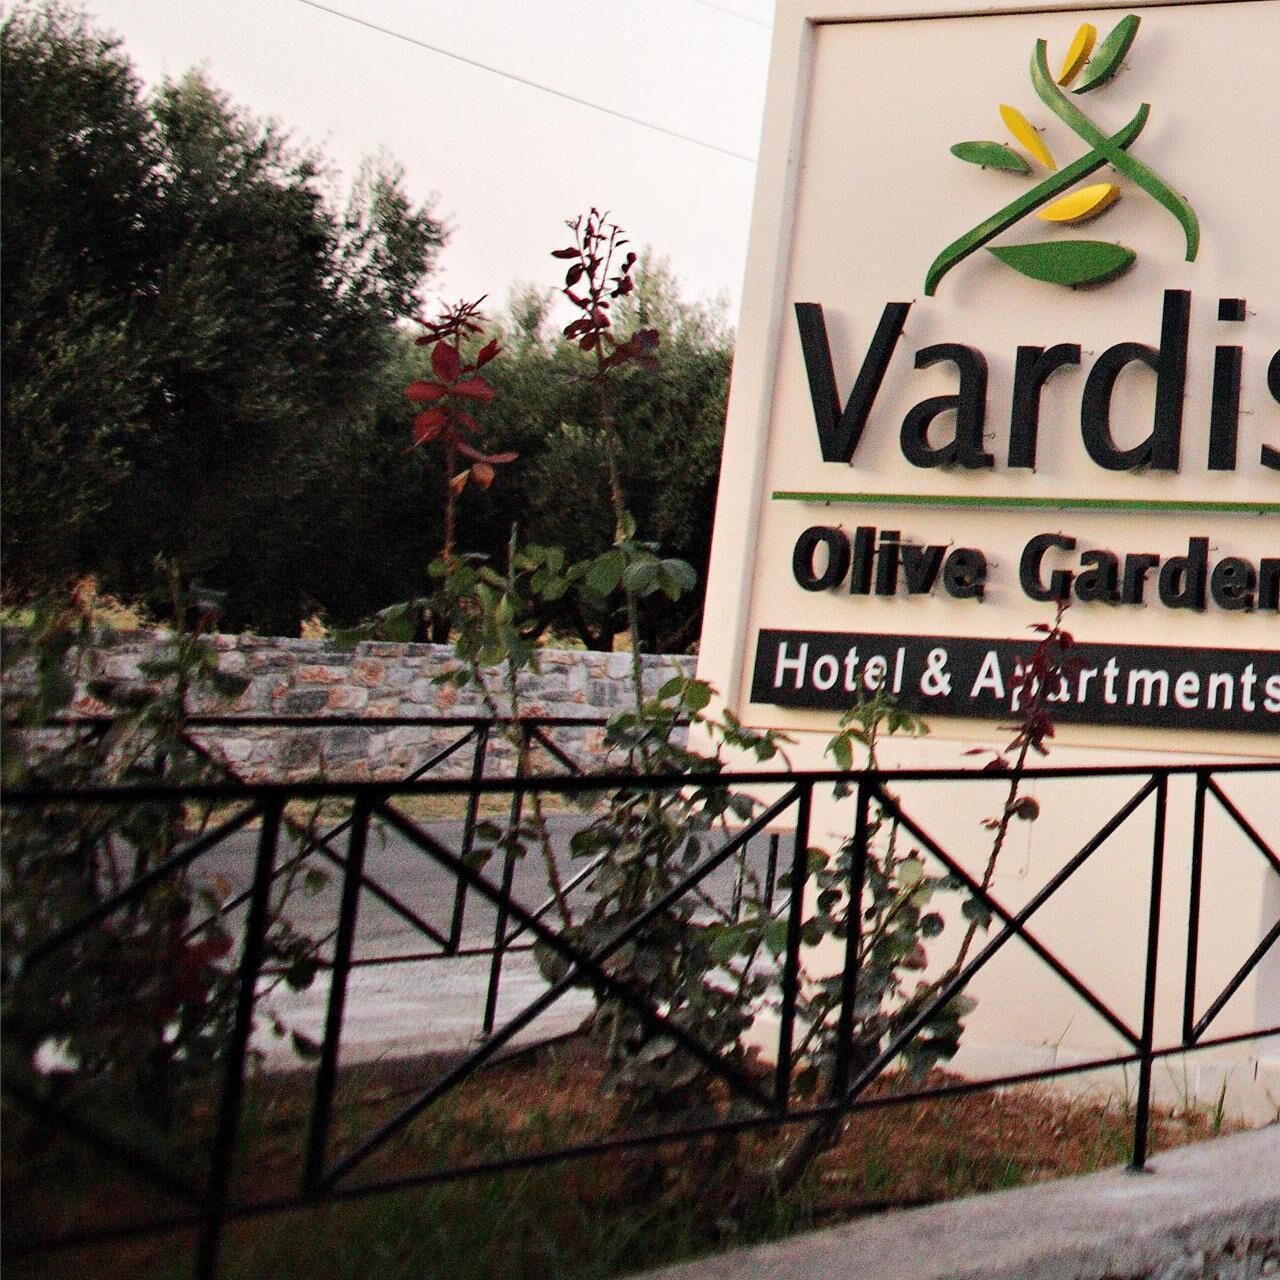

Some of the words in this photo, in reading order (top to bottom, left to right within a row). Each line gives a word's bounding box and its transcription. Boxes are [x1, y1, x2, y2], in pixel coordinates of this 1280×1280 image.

[792, 525, 988, 602] Olive
[774, 641, 906, 693] Hotel
[920, 647, 952, 697] &
